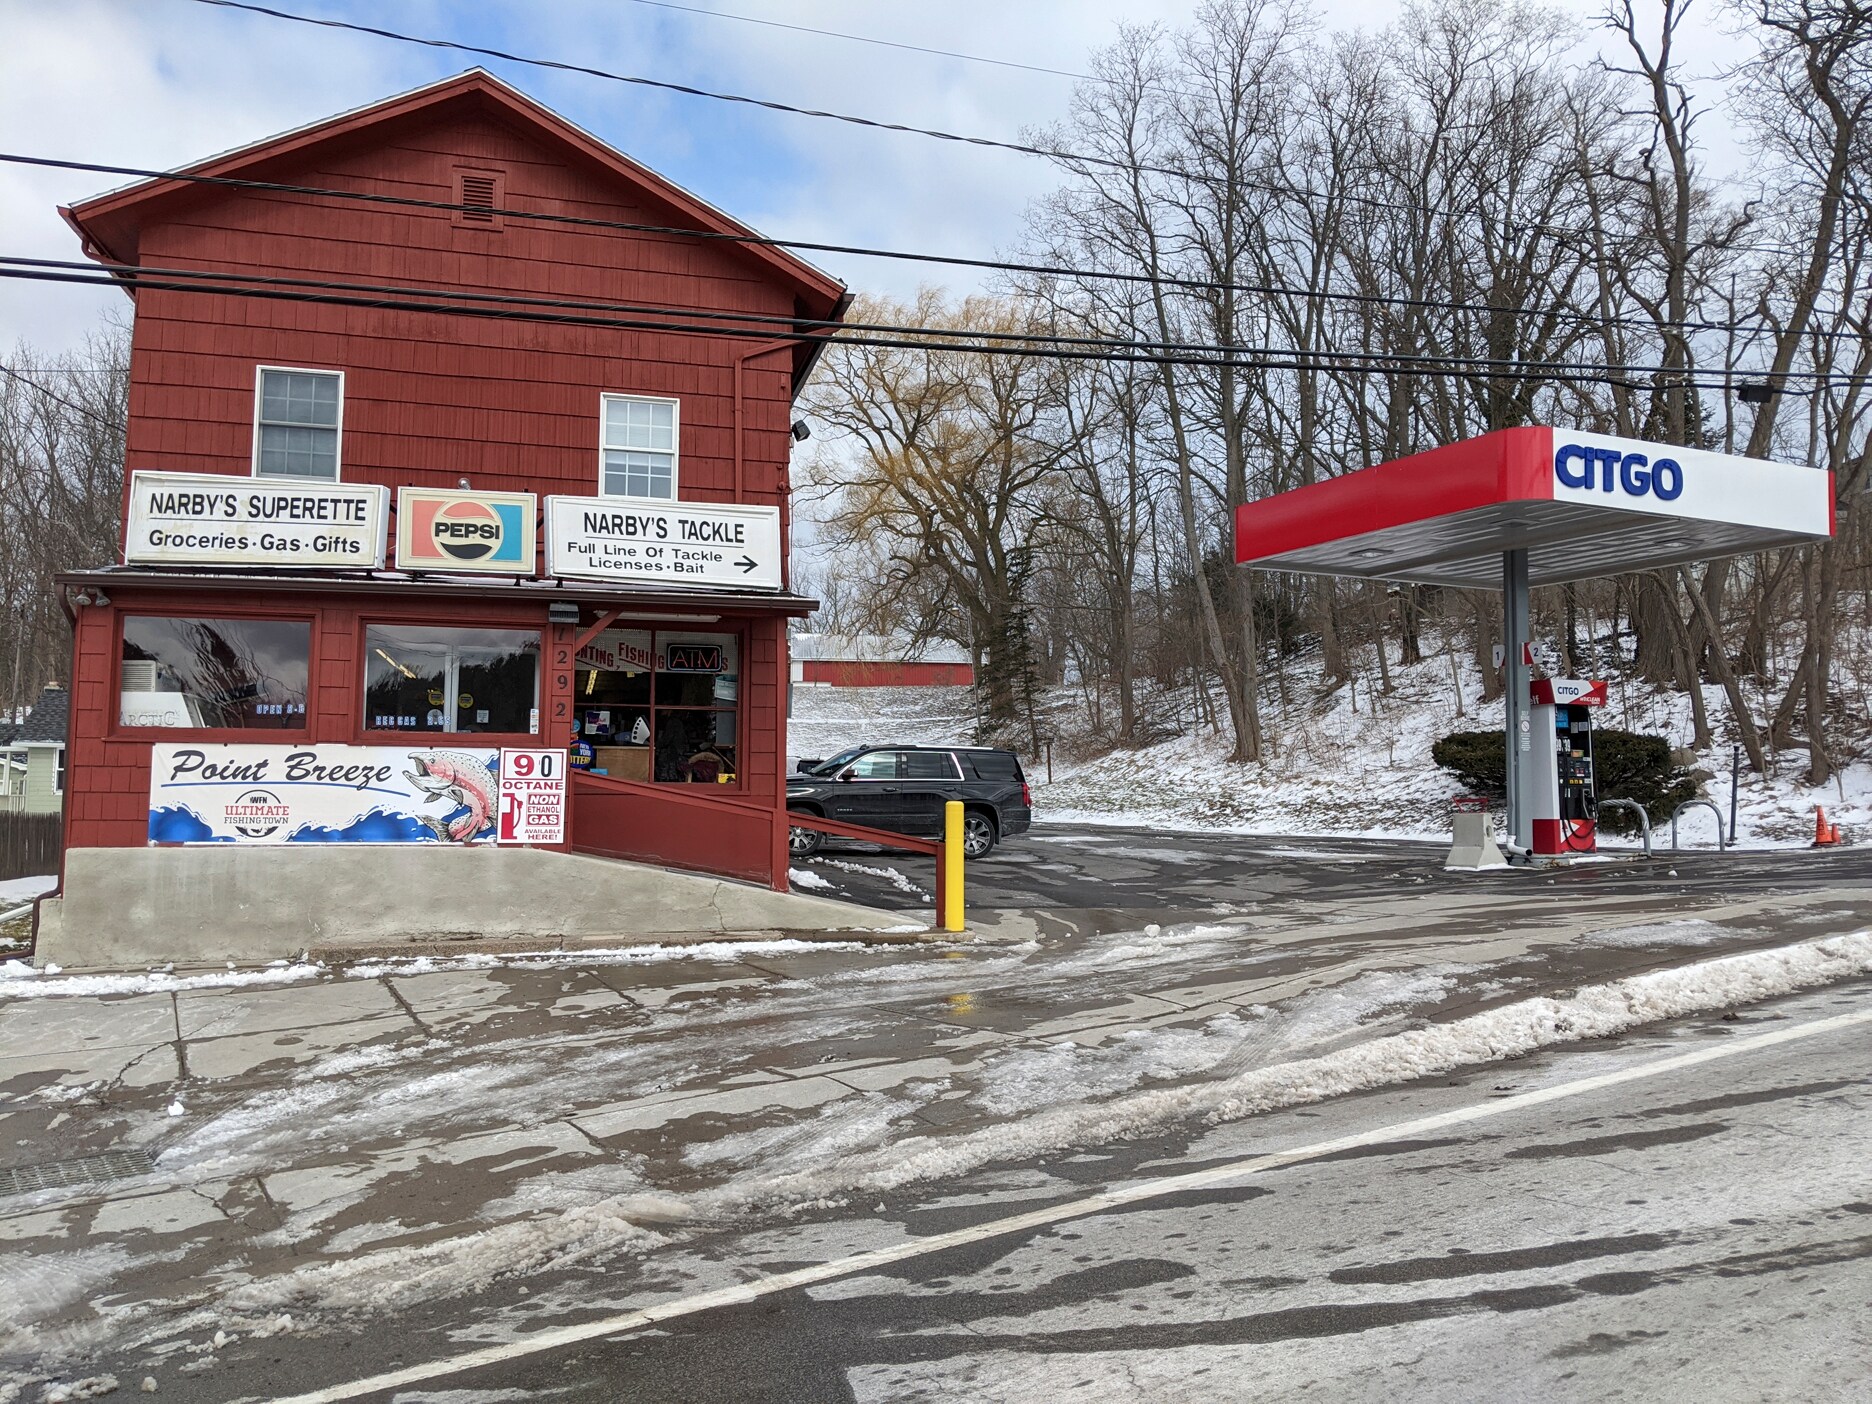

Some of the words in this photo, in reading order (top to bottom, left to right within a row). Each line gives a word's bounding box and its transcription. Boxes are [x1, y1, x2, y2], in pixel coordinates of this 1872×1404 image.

[1555, 444, 1684, 501] CITGO
[150, 493, 237, 517] NARBY'S
[248, 495, 367, 521] SUPERETTE
[435, 522, 500, 539] PEPSI
[584, 512, 668, 539] NARBY'S
[678, 519, 745, 544] TACKLE
[149, 530, 249, 550] Groceries
[260, 533, 300, 551] Gas
[313, 535, 360, 554] Gifts
[567, 542, 596, 554] Full
[604, 544, 637, 557] Line
[646, 546, 664, 558] Of
[672, 548, 723, 562] Tackle
[589, 557, 663, 571] Licenses
[674, 562, 704, 574] Bait
[1495, 651, 1500, 660] 1
[1533, 647, 1539, 657] 2
[671, 649, 718, 668] ATM
[1557, 686, 1579, 695] CITGO
[256, 704, 282, 714] OPEN
[375, 715, 395, 726] REG
[397, 715, 417, 726] GAS
[170, 750, 269, 781] Point
[284, 752, 393, 791] Breeze
[502, 781, 564, 790] OCTANE
[529, 795, 559, 804] NON
[224, 805, 290, 815] ULTIMATE
[223, 816, 262, 824] FISHING
[262, 816, 289, 824] TOWN
[528, 816, 558, 824] GAS
